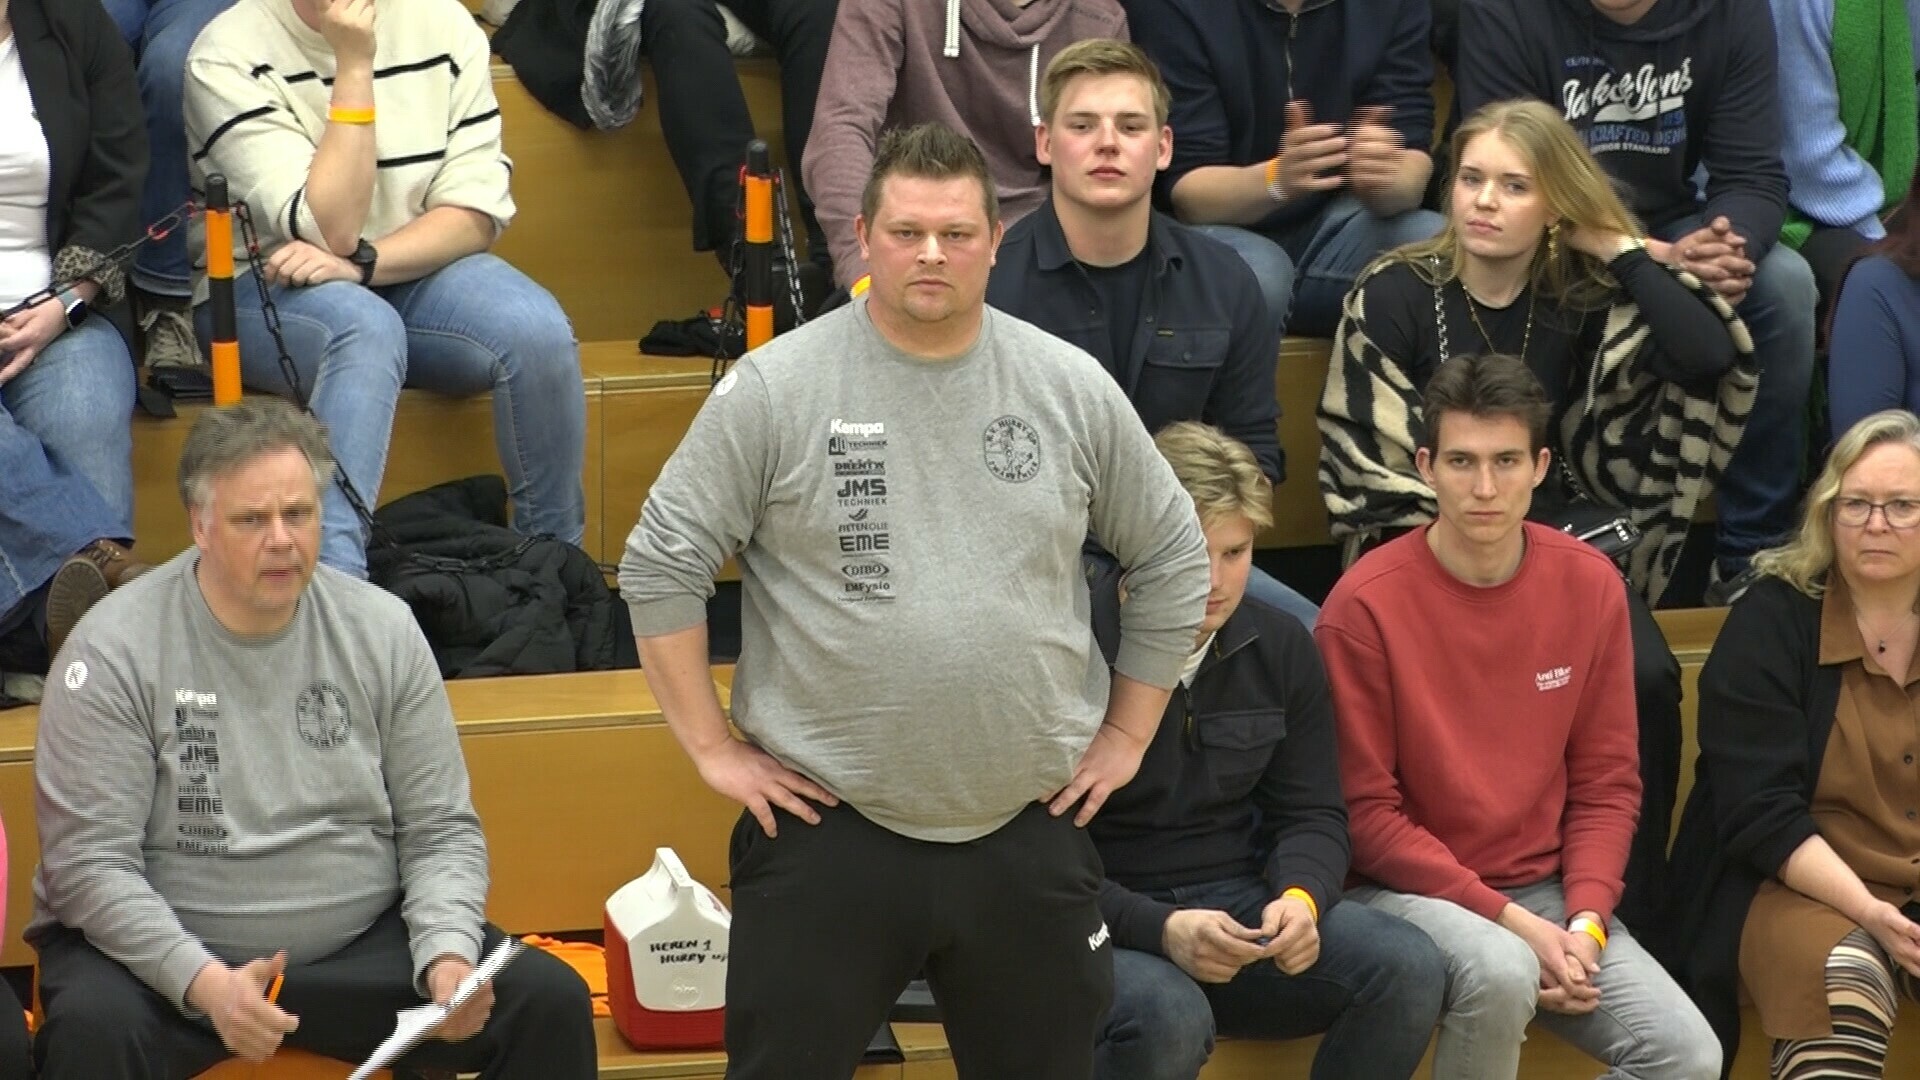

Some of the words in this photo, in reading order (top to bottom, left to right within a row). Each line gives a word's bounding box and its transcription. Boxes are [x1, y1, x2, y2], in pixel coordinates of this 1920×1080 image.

[1622, 142, 1671, 154] STANDARD
[830, 418, 884, 438] Kempa
[837, 478, 888, 498] JMS
[838, 497, 887, 507] TECHNIEK
[839, 533, 890, 552] EME
[178, 795, 224, 815] EME
[650, 940, 698, 952] HEREN
[703, 939, 712, 951] 1
[660, 952, 706, 964] HURRY
